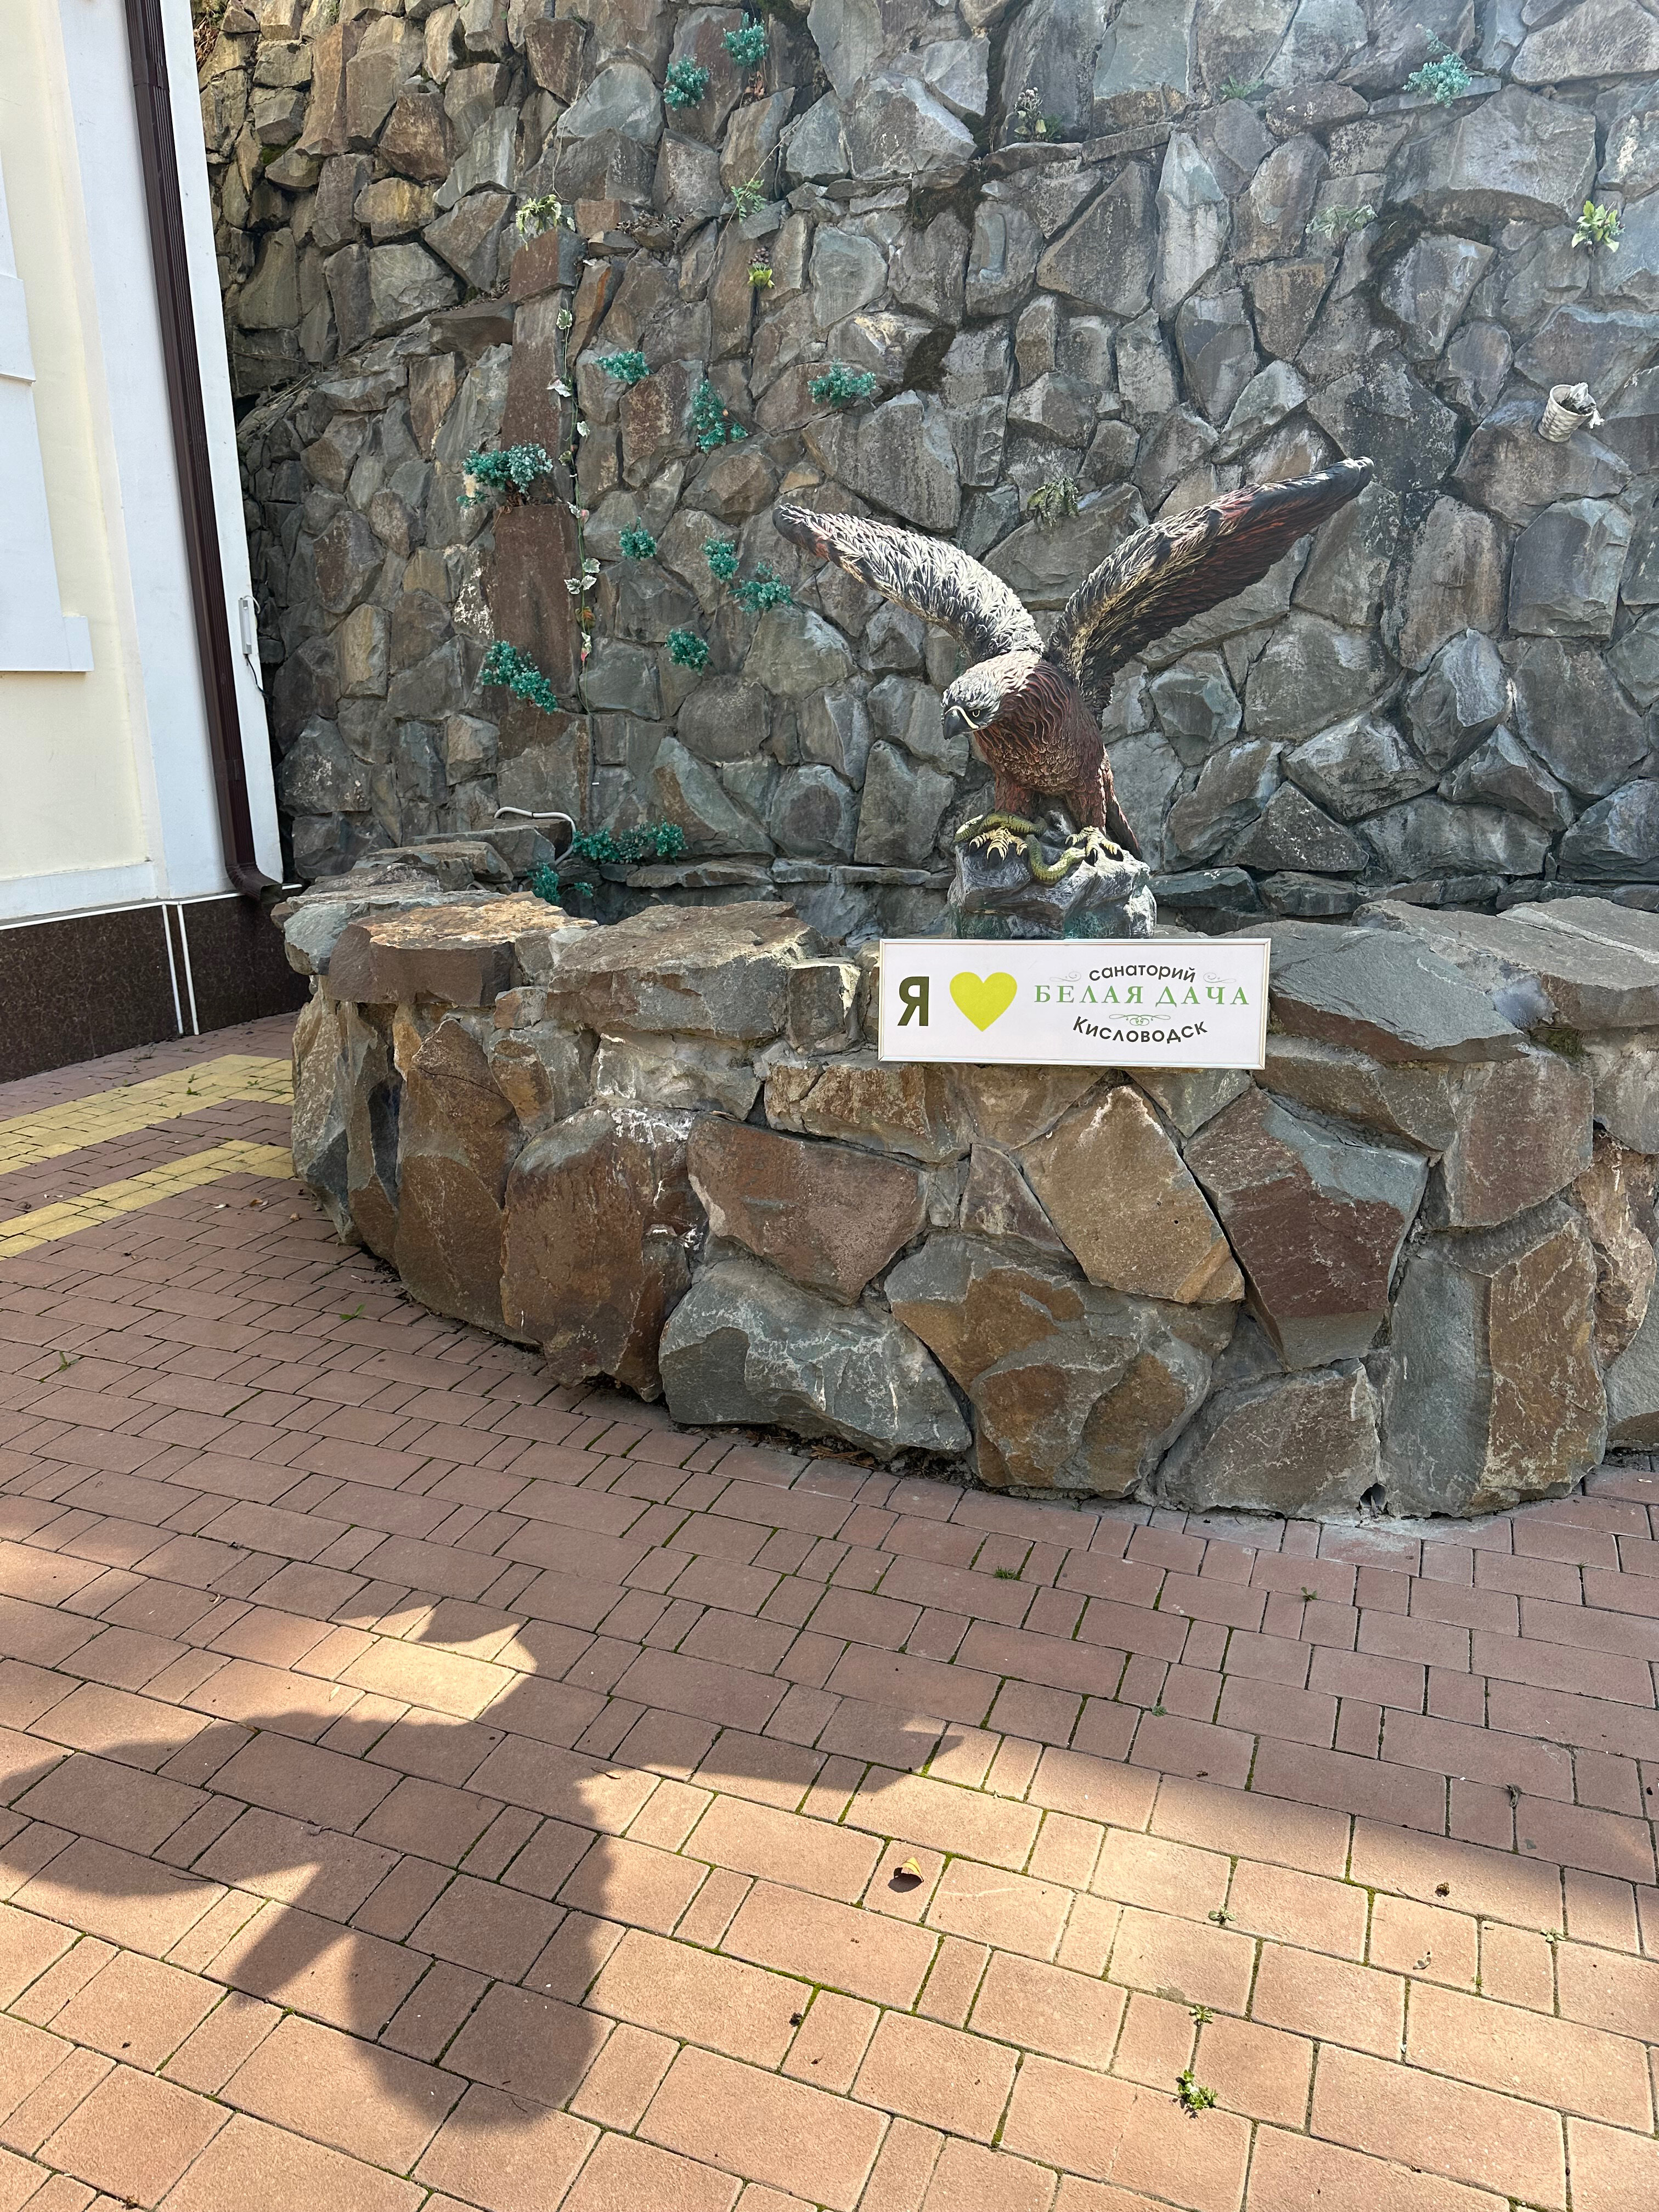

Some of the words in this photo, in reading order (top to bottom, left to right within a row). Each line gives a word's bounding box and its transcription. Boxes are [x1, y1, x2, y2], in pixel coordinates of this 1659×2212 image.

[1089, 964, 1196, 983] санаторий
[897, 977, 929, 1026] Я
[1034, 985, 1144, 1004] БЕЛАЯ
[1155, 986, 1250, 1007] ДАЧА
[1073, 1017, 1207, 1043] Кисловодск
